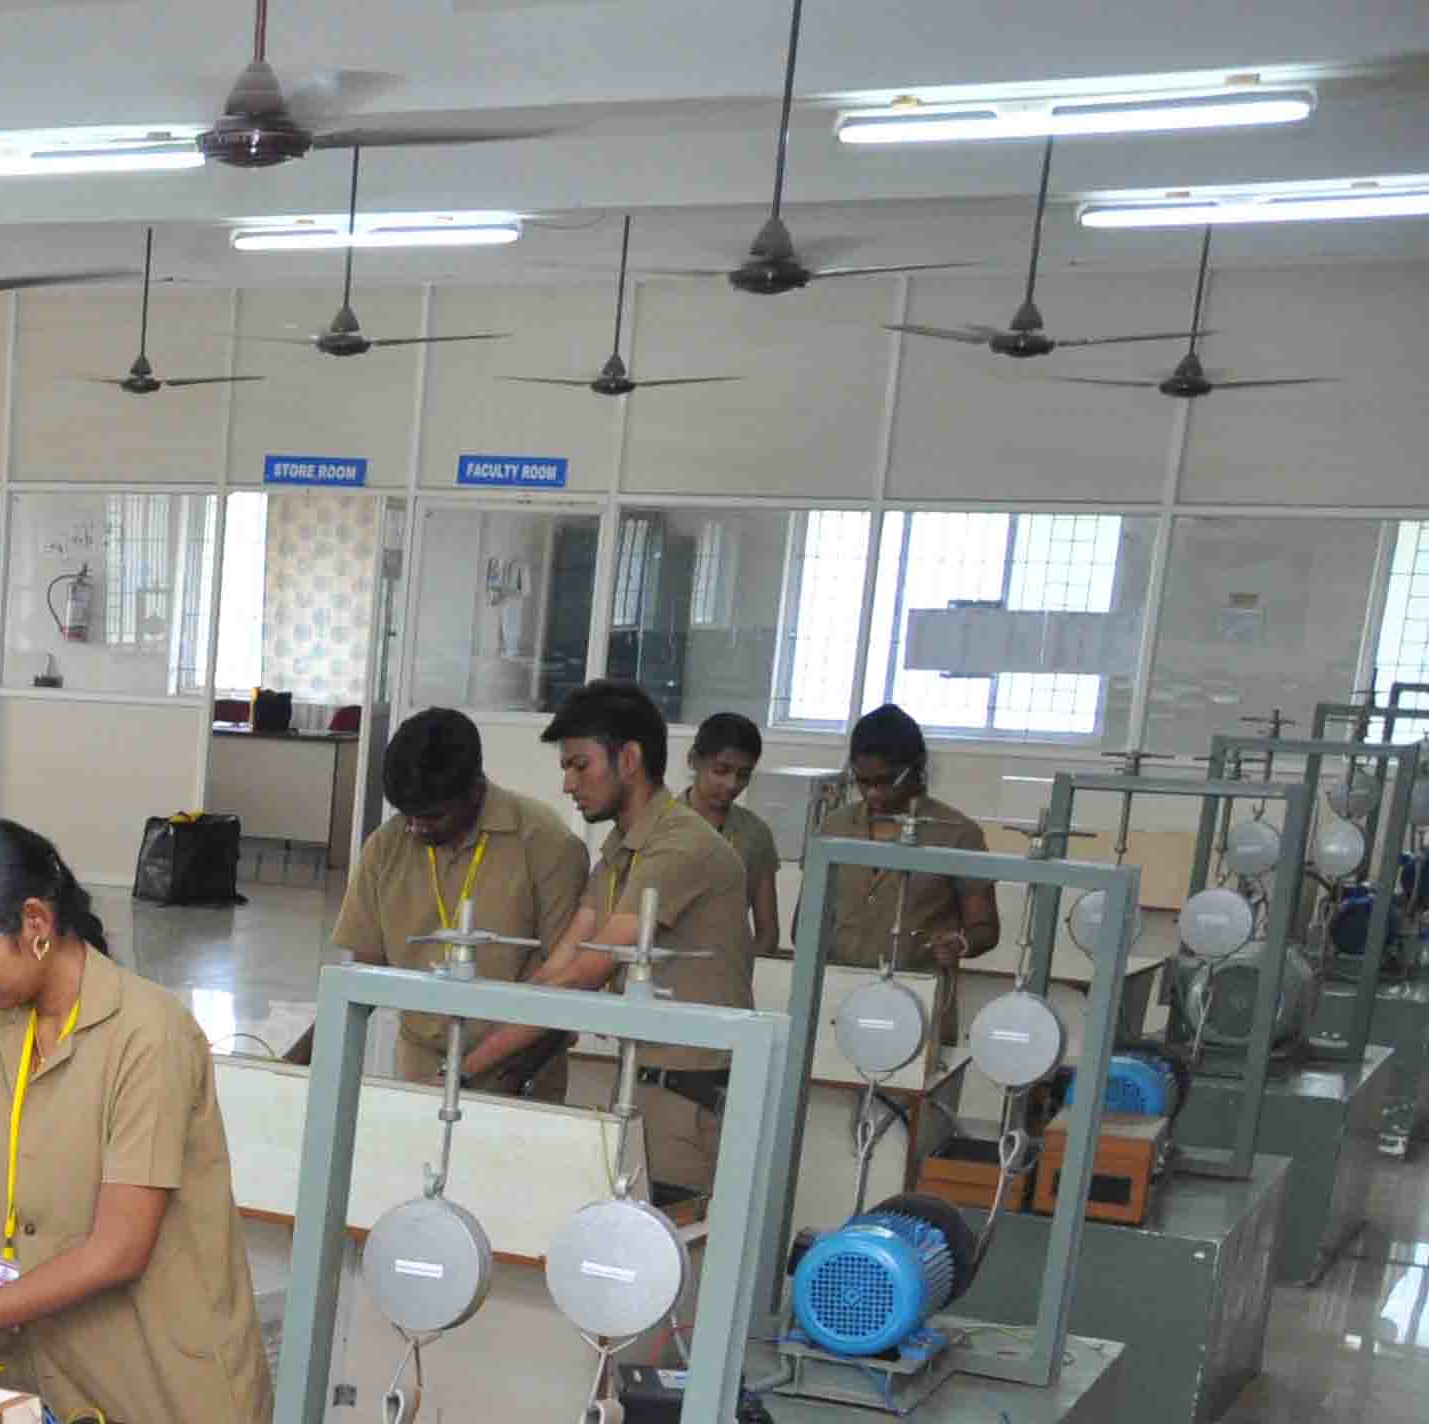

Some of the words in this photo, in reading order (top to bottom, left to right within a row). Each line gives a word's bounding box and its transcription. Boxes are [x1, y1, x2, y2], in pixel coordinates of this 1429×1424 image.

[273, 463, 316, 478] STORE
[317, 465, 357, 480] ROOM
[466, 462, 519, 479] FACULTY
[520, 464, 558, 480] ROOM
